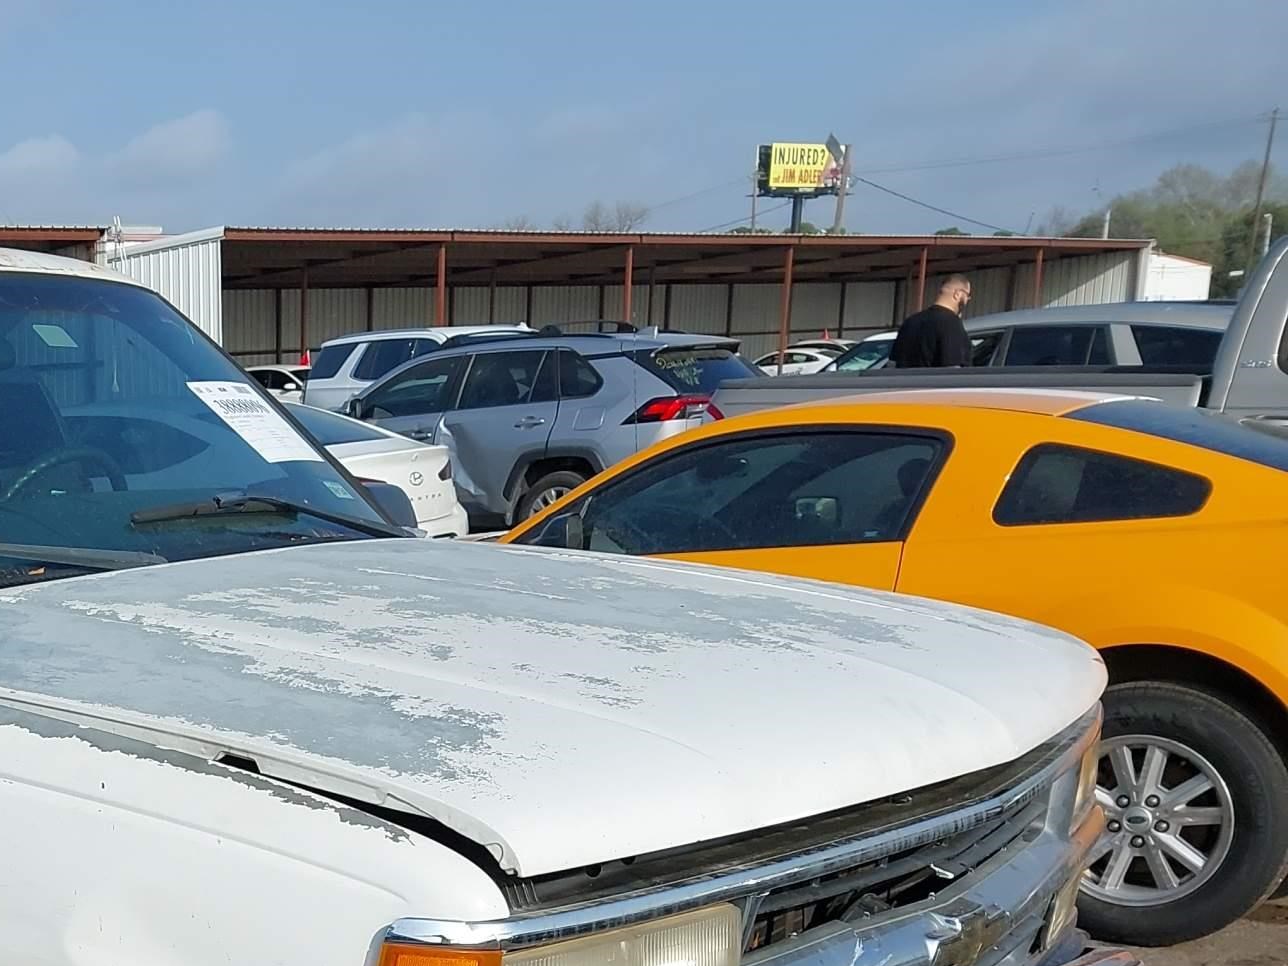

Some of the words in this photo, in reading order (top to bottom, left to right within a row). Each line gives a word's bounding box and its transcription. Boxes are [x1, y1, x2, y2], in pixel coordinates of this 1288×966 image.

[773, 147, 826, 166] INJURED?
[781, 168, 796, 183] JIM
[798, 168, 824, 184] ADLER
